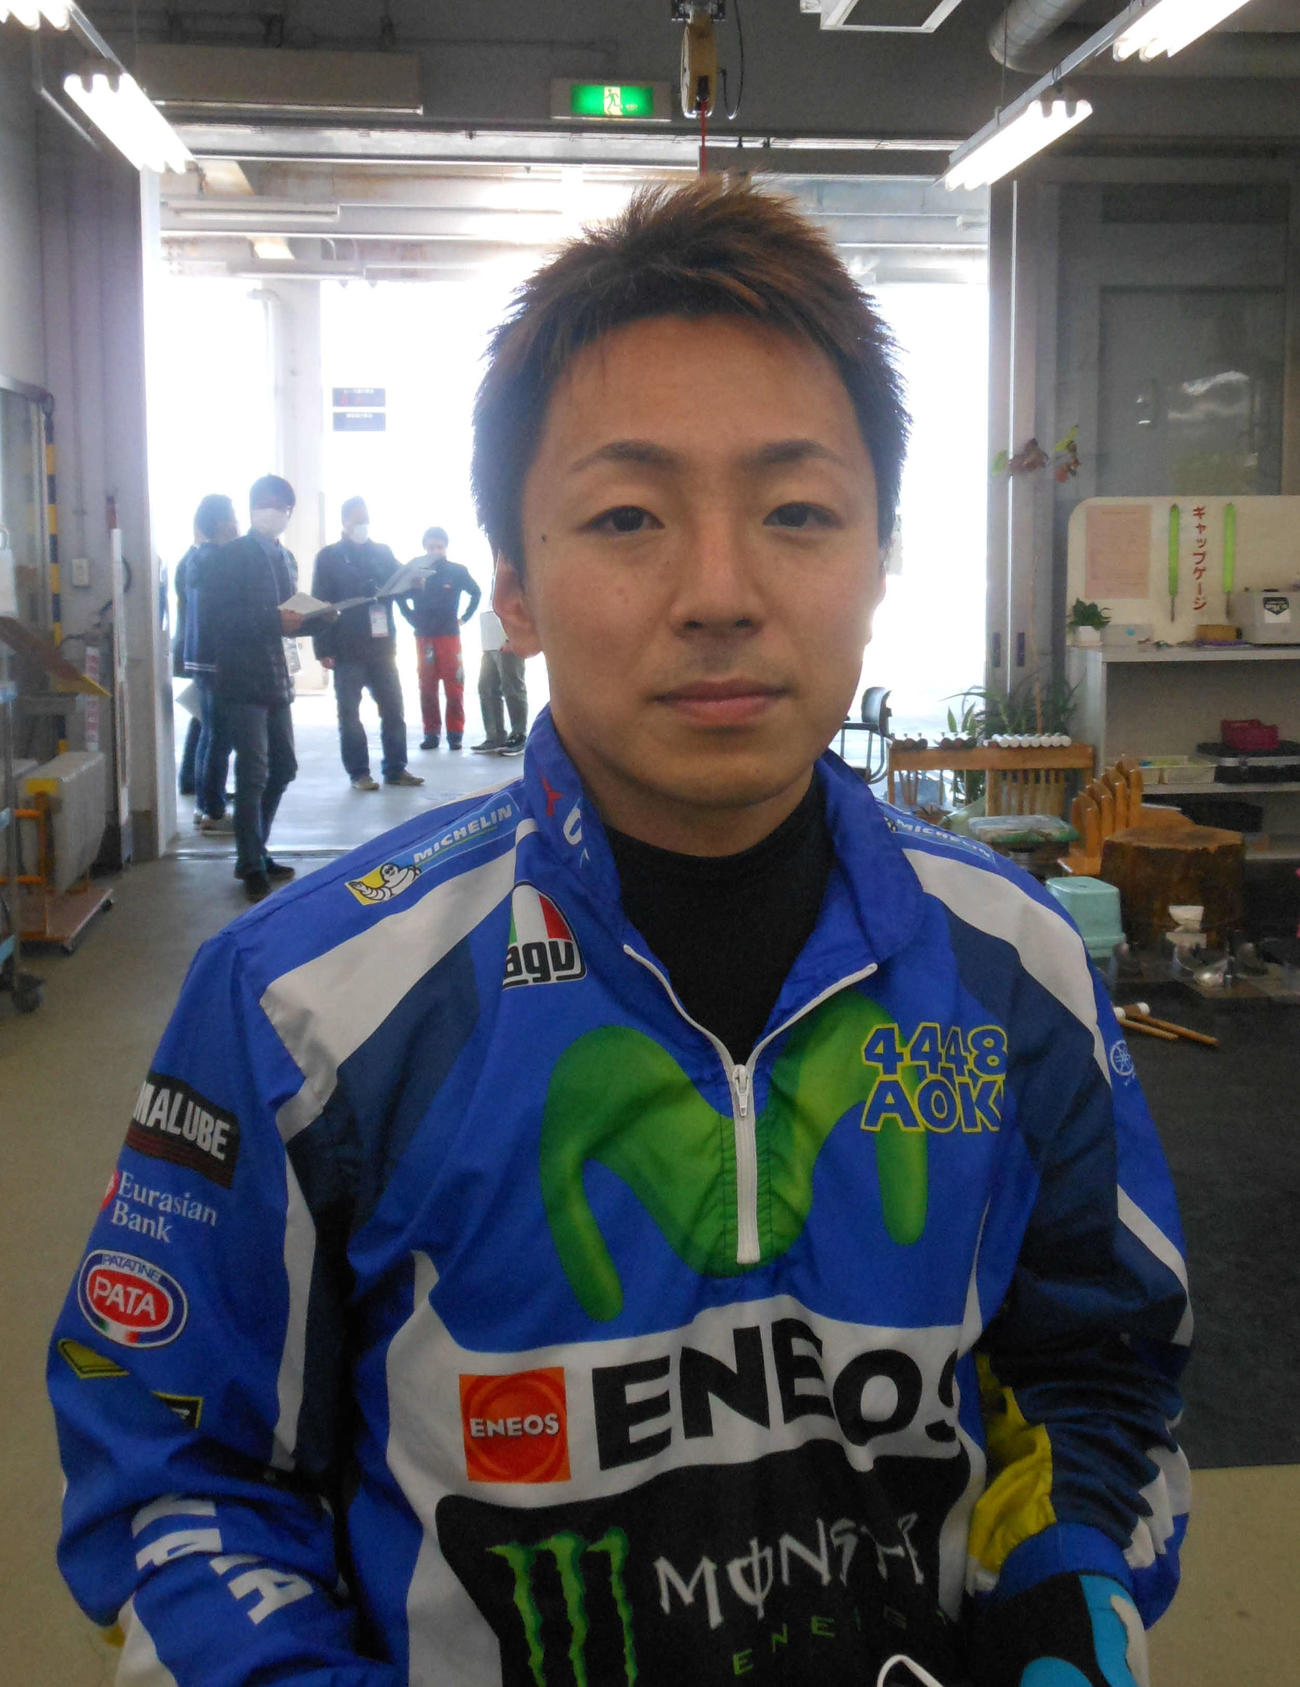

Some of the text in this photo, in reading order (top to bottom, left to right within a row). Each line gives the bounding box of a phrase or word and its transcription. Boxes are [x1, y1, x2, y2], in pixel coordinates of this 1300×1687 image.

[413, 803, 513, 864] MICHELIN
[861, 1022, 1008, 1079] 4448
[860, 1075, 1005, 1134] AOK
[112, 1200, 173, 1243] Bank
[117, 1171, 217, 1226] Eurasian
[93, 1275, 156, 1321] PATA
[470, 1413, 559, 1438] ENEOS
